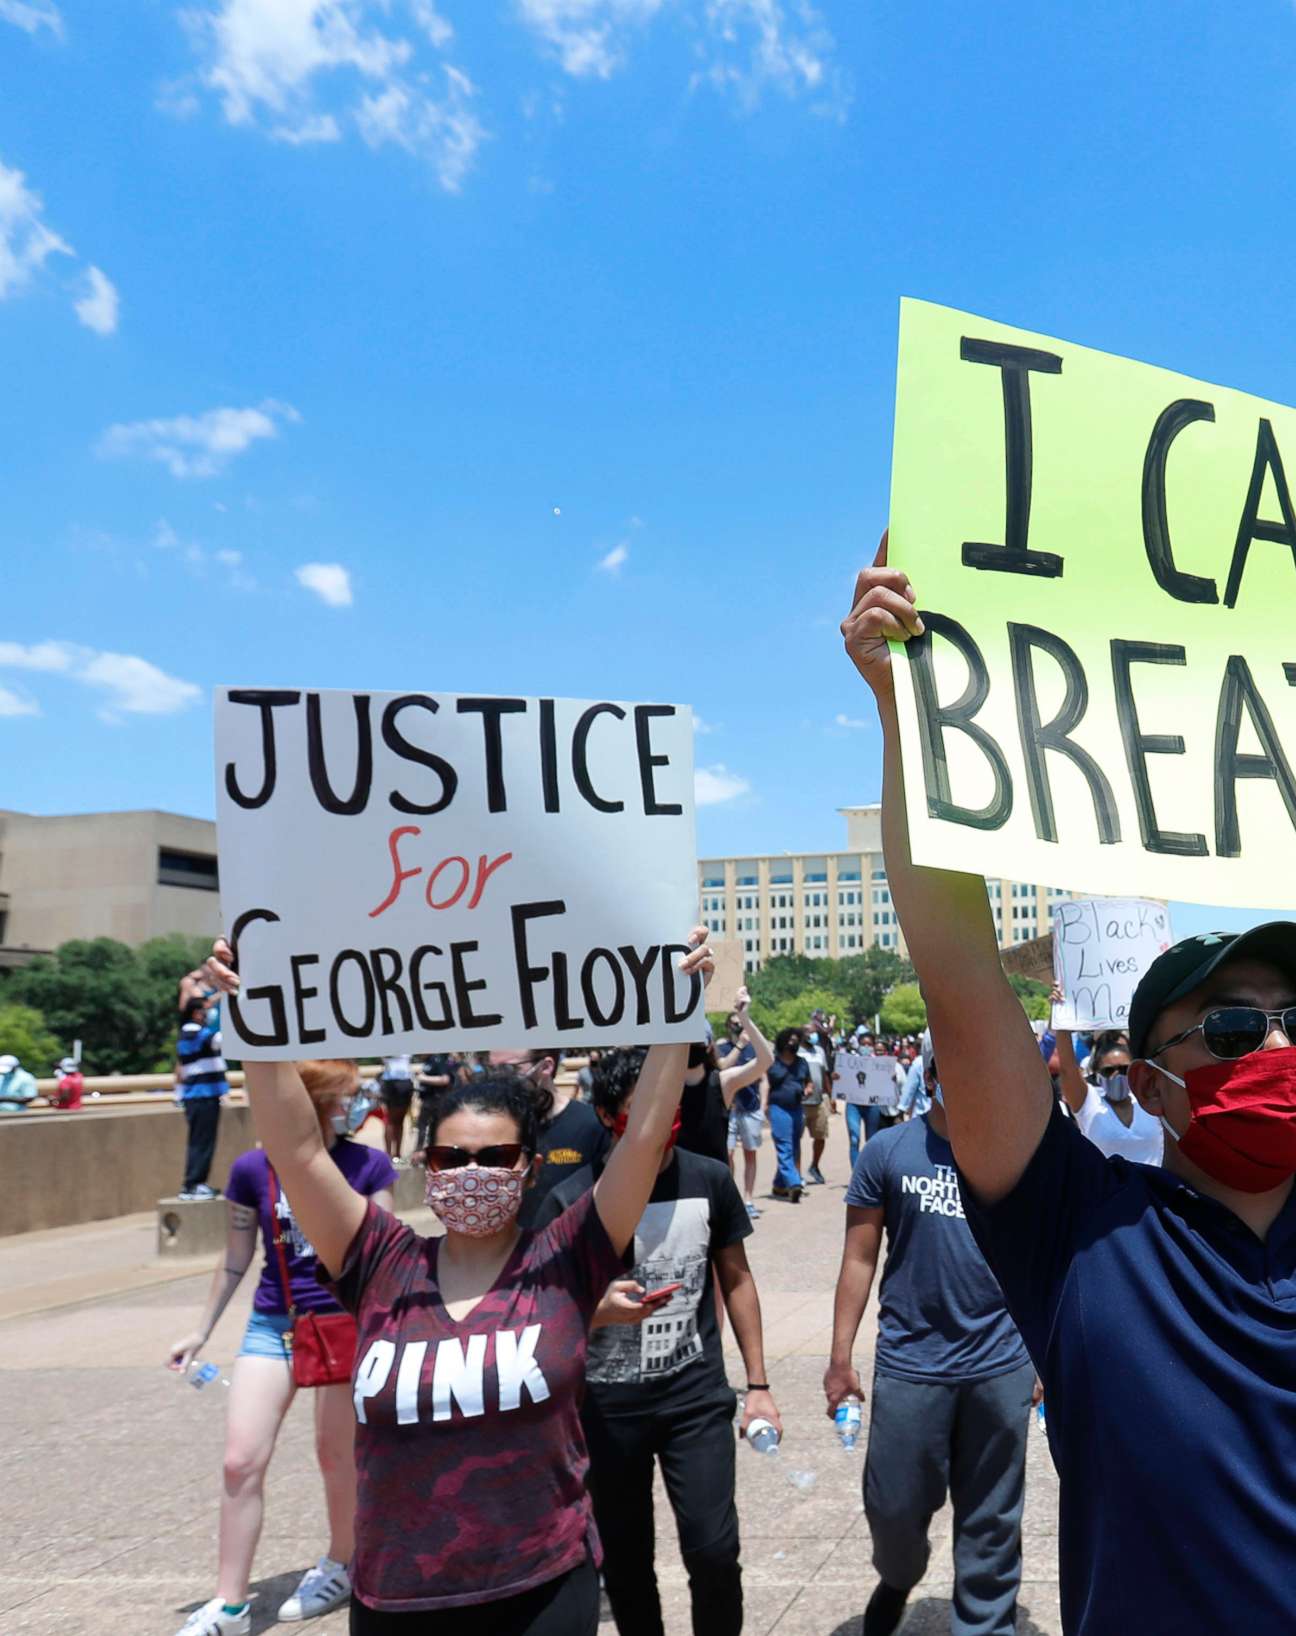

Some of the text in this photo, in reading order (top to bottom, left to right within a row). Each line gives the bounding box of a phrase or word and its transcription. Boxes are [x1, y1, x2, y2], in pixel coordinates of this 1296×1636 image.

[959, 336, 1064, 579] I
[224, 689, 683, 817] JUSTICE
[228, 899, 703, 1048] GEORGE FLOYD
[1058, 902, 1161, 945] Black
[1077, 948, 1139, 981] Lives
[353, 1323, 551, 1425] PINK
